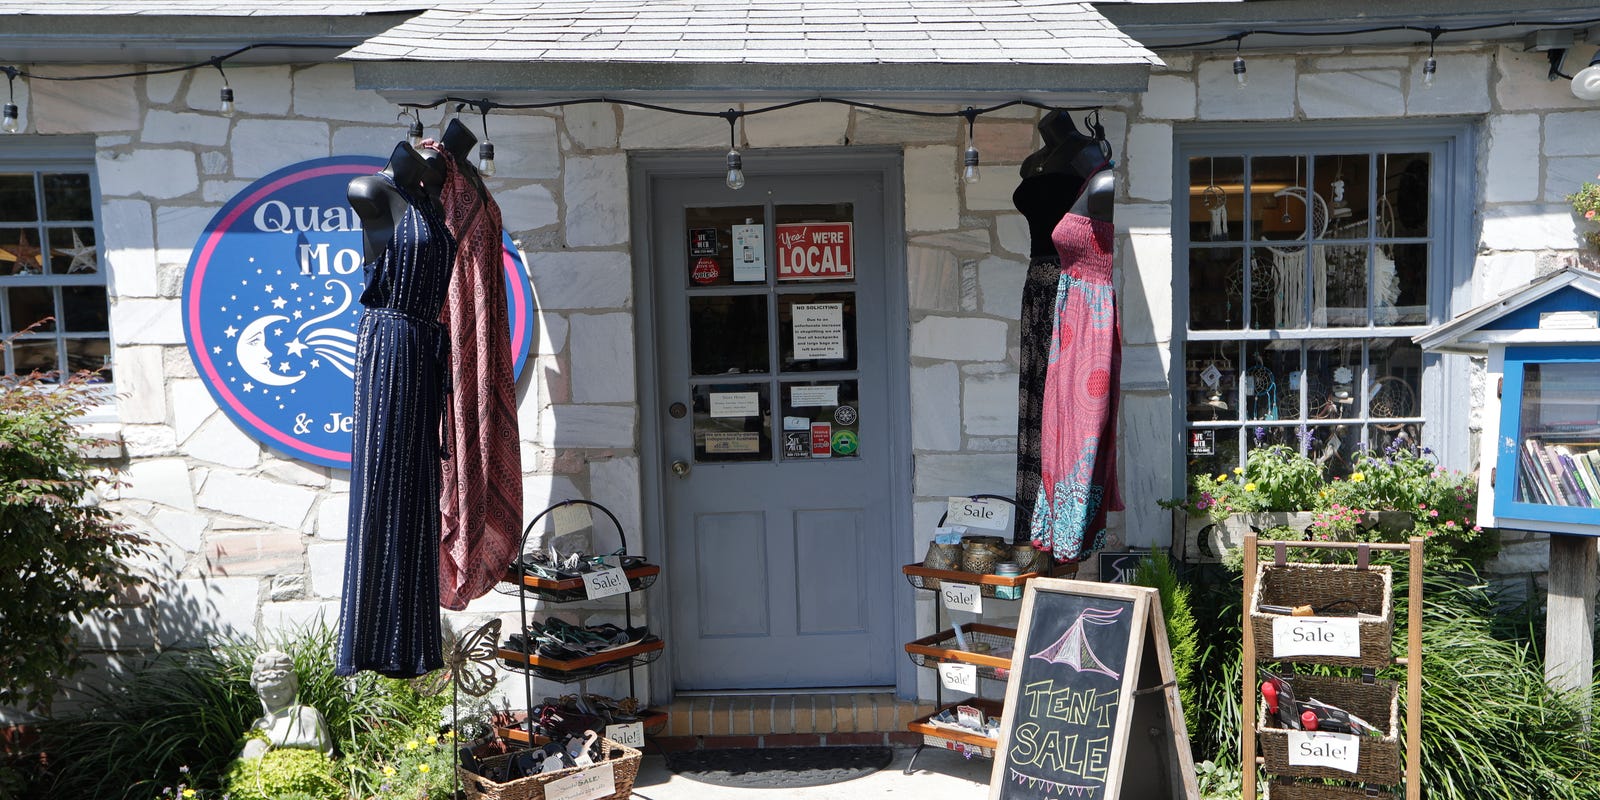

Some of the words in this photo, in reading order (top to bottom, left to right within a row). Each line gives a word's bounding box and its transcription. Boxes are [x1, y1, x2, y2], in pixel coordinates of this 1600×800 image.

[778, 226, 807, 249] Yes!
[812, 232, 844, 244] WE'RE
[299, 243, 365, 276] Mo
[779, 246, 848, 274] LOCAL
[293, 412, 314, 434] &
[323, 412, 353, 434] Je
[963, 504, 994, 520] Sale
[592, 574, 622, 590] Sale!
[945, 589, 974, 606] Sale!
[1291, 626, 1335, 643] Sale
[945, 672, 970, 685] Sale!
[1024, 679, 1120, 728] TENT
[611, 731, 636, 744] Sale!
[1010, 722, 1109, 782] SALE
[1299, 742, 1347, 761] Sale!
